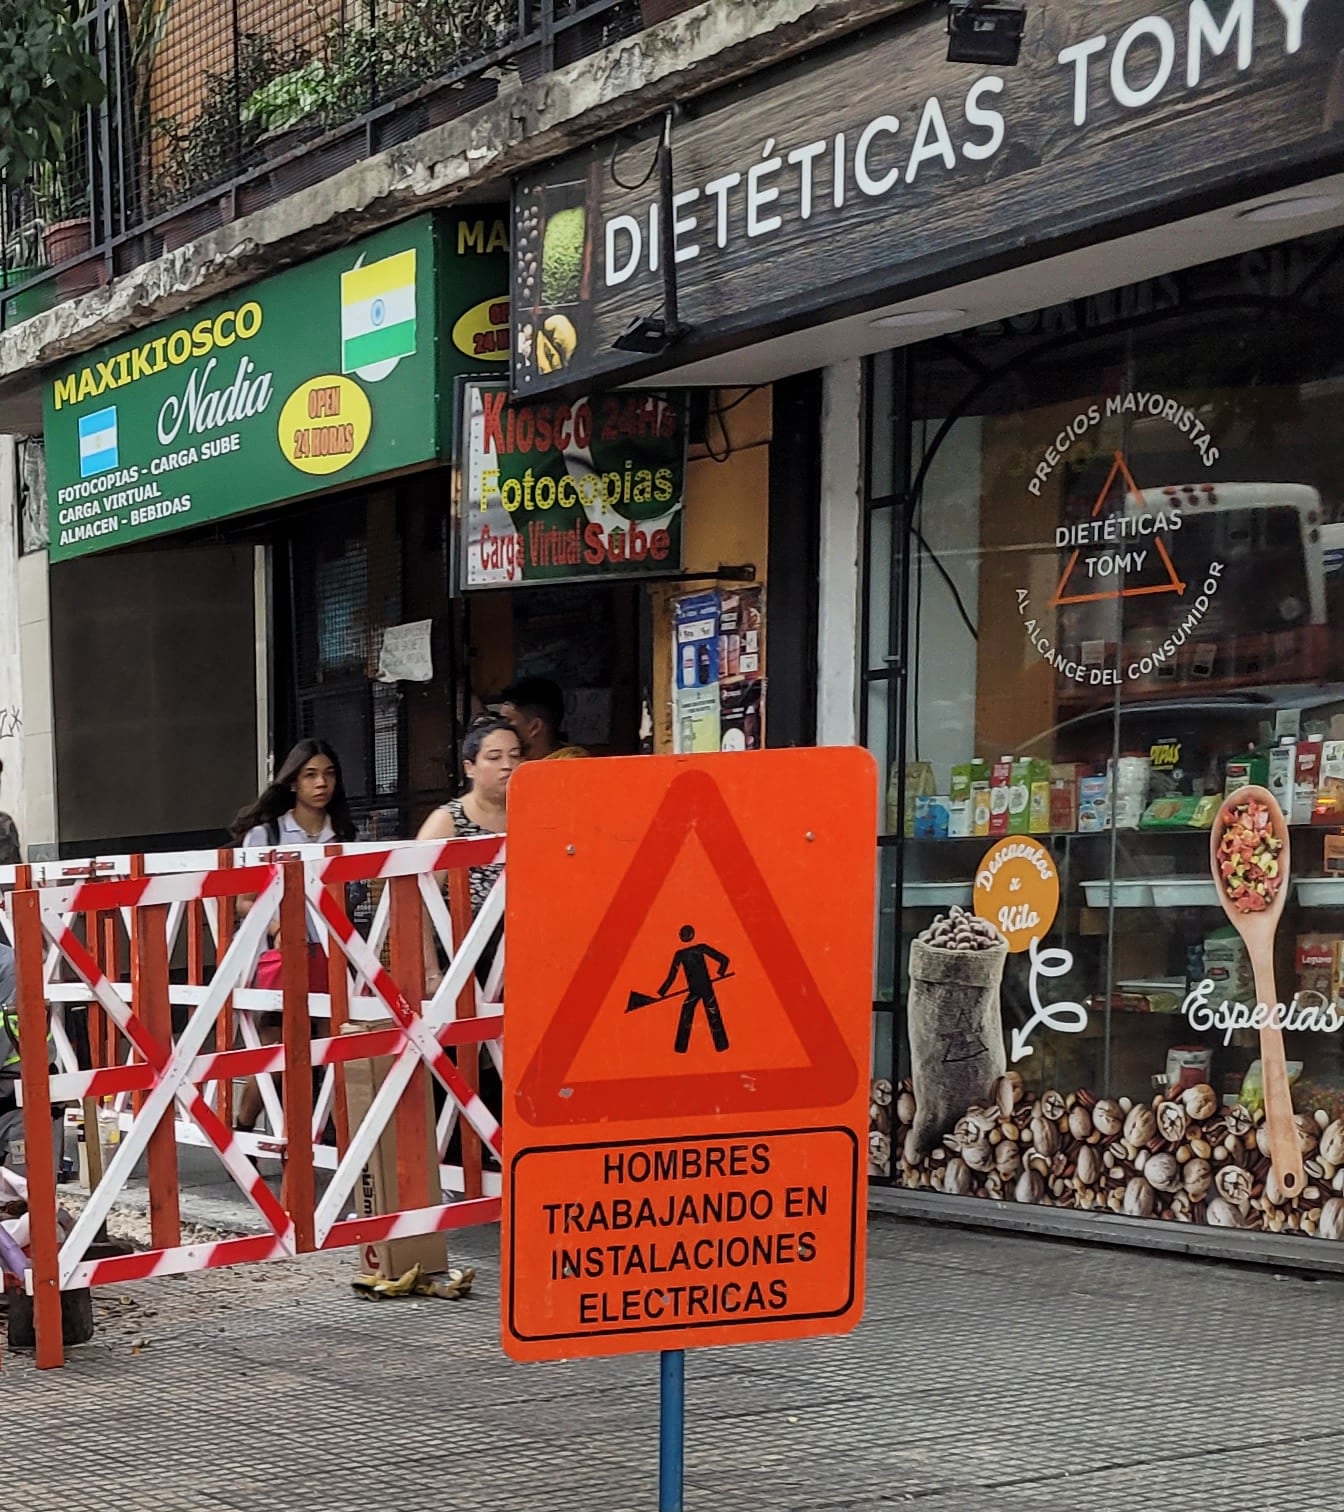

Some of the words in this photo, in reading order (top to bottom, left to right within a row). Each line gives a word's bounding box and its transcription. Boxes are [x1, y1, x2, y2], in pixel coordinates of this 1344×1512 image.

[604, 75, 1007, 288] DIETÉTICAS
[1057, 0, 1313, 127] TOMY
[53, 301, 264, 411] MAXIKIOSCO
[157, 356, 275, 446] Nadia
[308, 385, 340, 419] OPEN
[294, 429, 310, 459] 24
[311, 422, 354, 457] HORAS
[1028, 405, 1100, 497] PRECIOS
[1105, 391, 1221, 468] MAYORISTAS
[58, 466, 139, 505] FOTOCOPIAS
[150, 447, 198, 475] CARGA
[201, 433, 240, 460] SUBE
[479, 460, 674, 515] Fotocopias
[59, 500, 101, 525] CARGA
[103, 482, 161, 512] VIRTUAL
[59, 515, 119, 546] ALMACEN
[130, 494, 191, 526] BEBIDAS
[480, 524, 525, 580] Carga
[528, 520, 581, 567] Virtual
[584, 519, 671, 565] Sube
[1055, 509, 1182, 548] DIETÉTICAS
[1085, 550, 1148, 578] TOMY
[1015, 587, 1029, 615] AL
[1023, 619, 1086, 684] ALCANCE
[1090, 668, 1122, 686] DEL
[1128, 561, 1225, 679] CONSUMIDOR
[976, 844, 1053, 892] Descuentos
[998, 904, 1040, 932] Kilo
[1181, 979, 1344, 1046] Especias
[604, 1143, 771, 1184] HOMBRES
[543, 1188, 774, 1234] TRABAJANDO
[785, 1185, 828, 1217] EN
[552, 1231, 817, 1280] INSTALACIONES
[580, 1279, 787, 1324] ELECTRICAS
